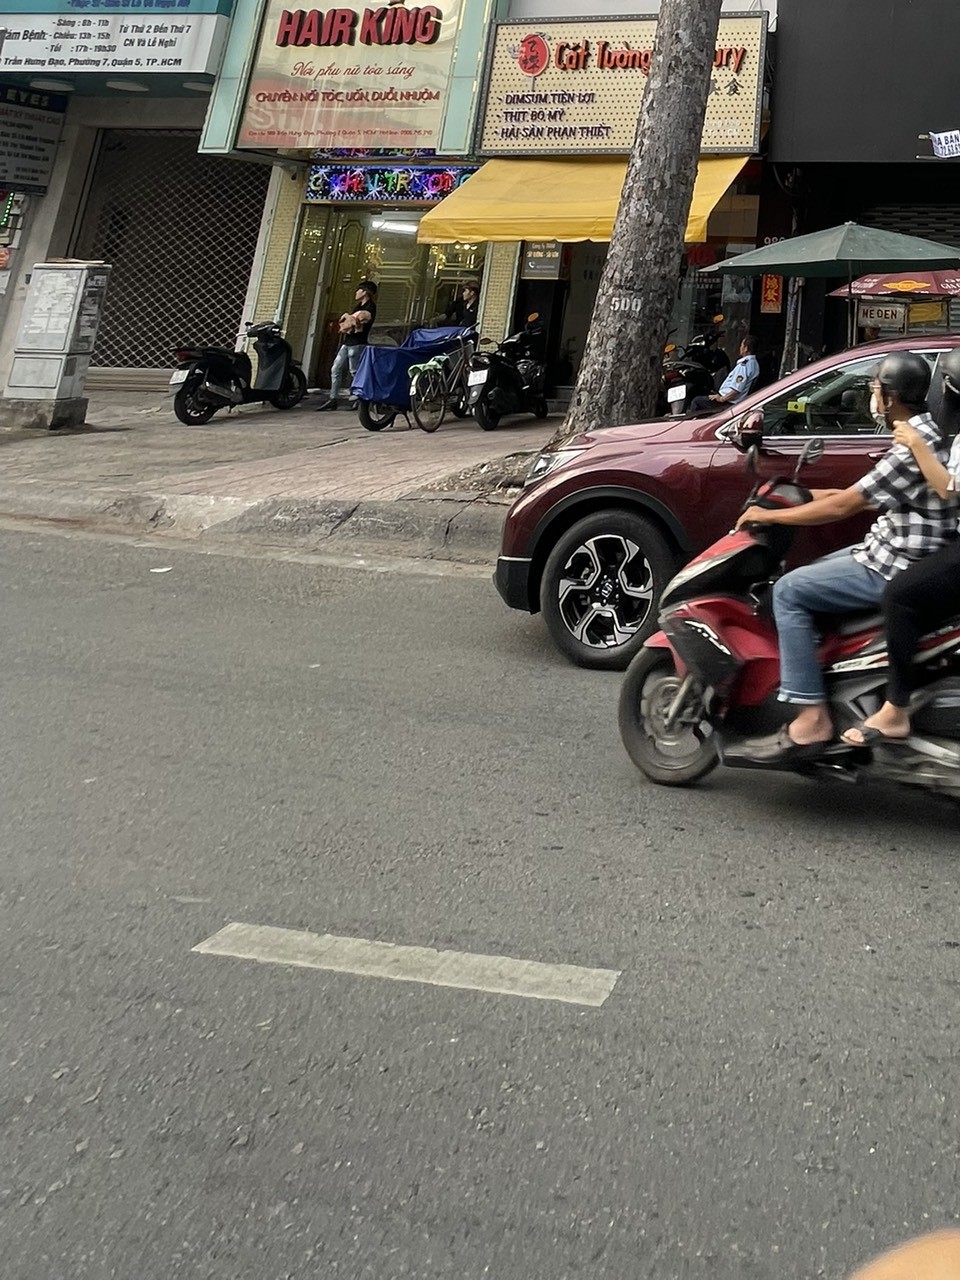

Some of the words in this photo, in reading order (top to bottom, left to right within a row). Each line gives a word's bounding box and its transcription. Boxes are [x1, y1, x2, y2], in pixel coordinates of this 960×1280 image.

[146, 25, 152, 33] 2
[185, 25, 191, 33] 7
[276, 9, 359, 47] HAIR
[360, 5, 443, 46] KING
[123, 38, 134, 47] CN
[4, 56, 22, 65] Trần
[146, 58, 182, 66] TP.HCM
[386, 62, 415, 80] sáng
[300, 88, 319, 102] NỐI
[505, 93, 548, 105] DIMSUM
[547, 127, 576, 137] PHAN
[609, 296, 643, 311] 500
